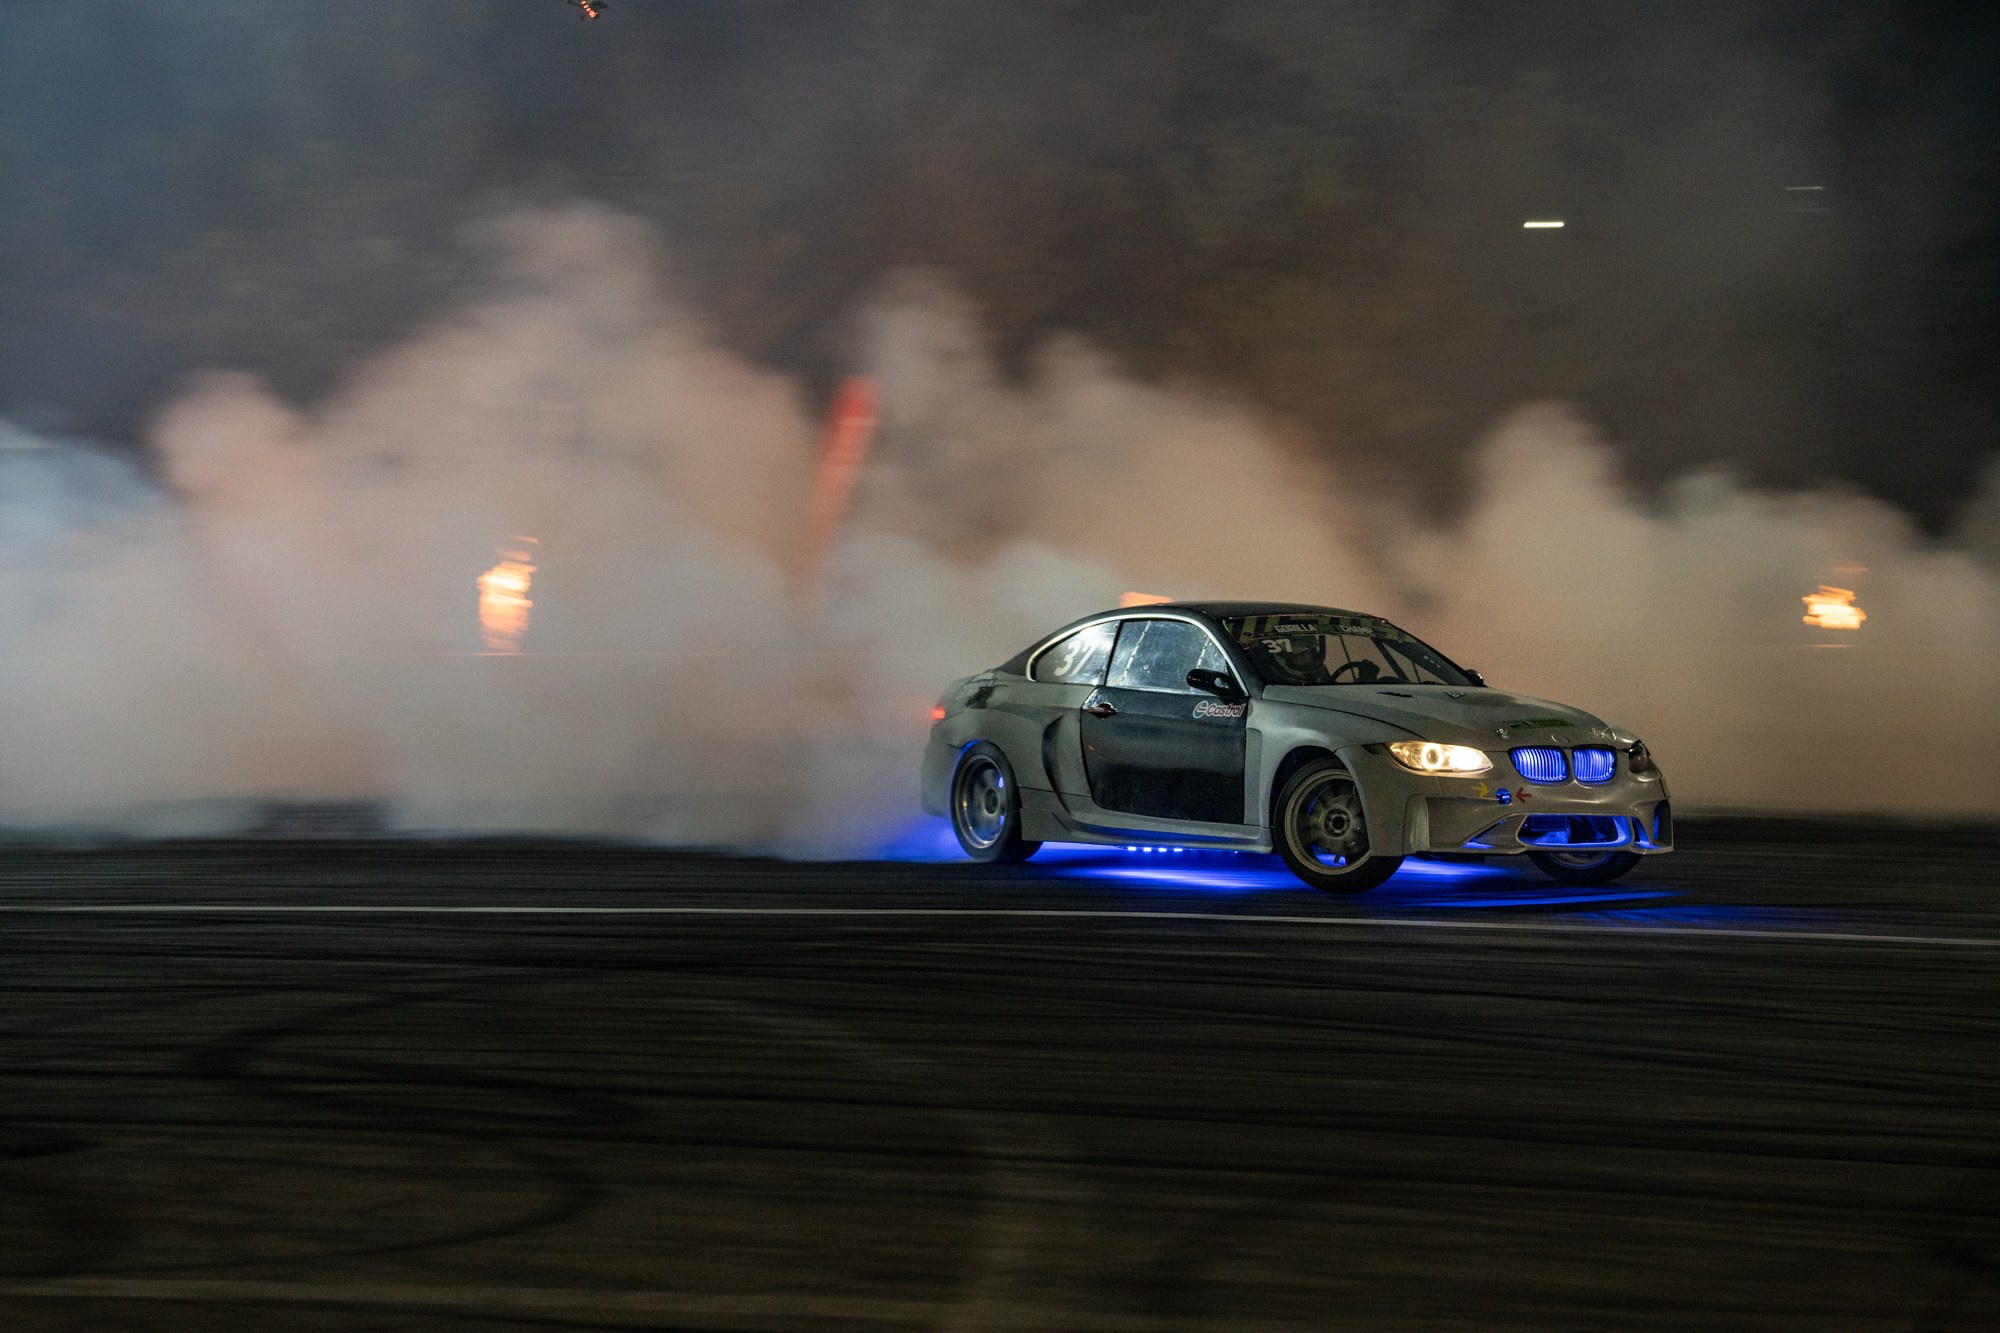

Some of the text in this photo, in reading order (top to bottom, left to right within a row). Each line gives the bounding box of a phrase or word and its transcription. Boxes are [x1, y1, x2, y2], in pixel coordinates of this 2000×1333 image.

[1273, 623, 1317, 633] GORILLA
[1261, 638, 1293, 654] 37
[1053, 639, 1098, 678] 37
[1206, 703, 1246, 717] Castrol
